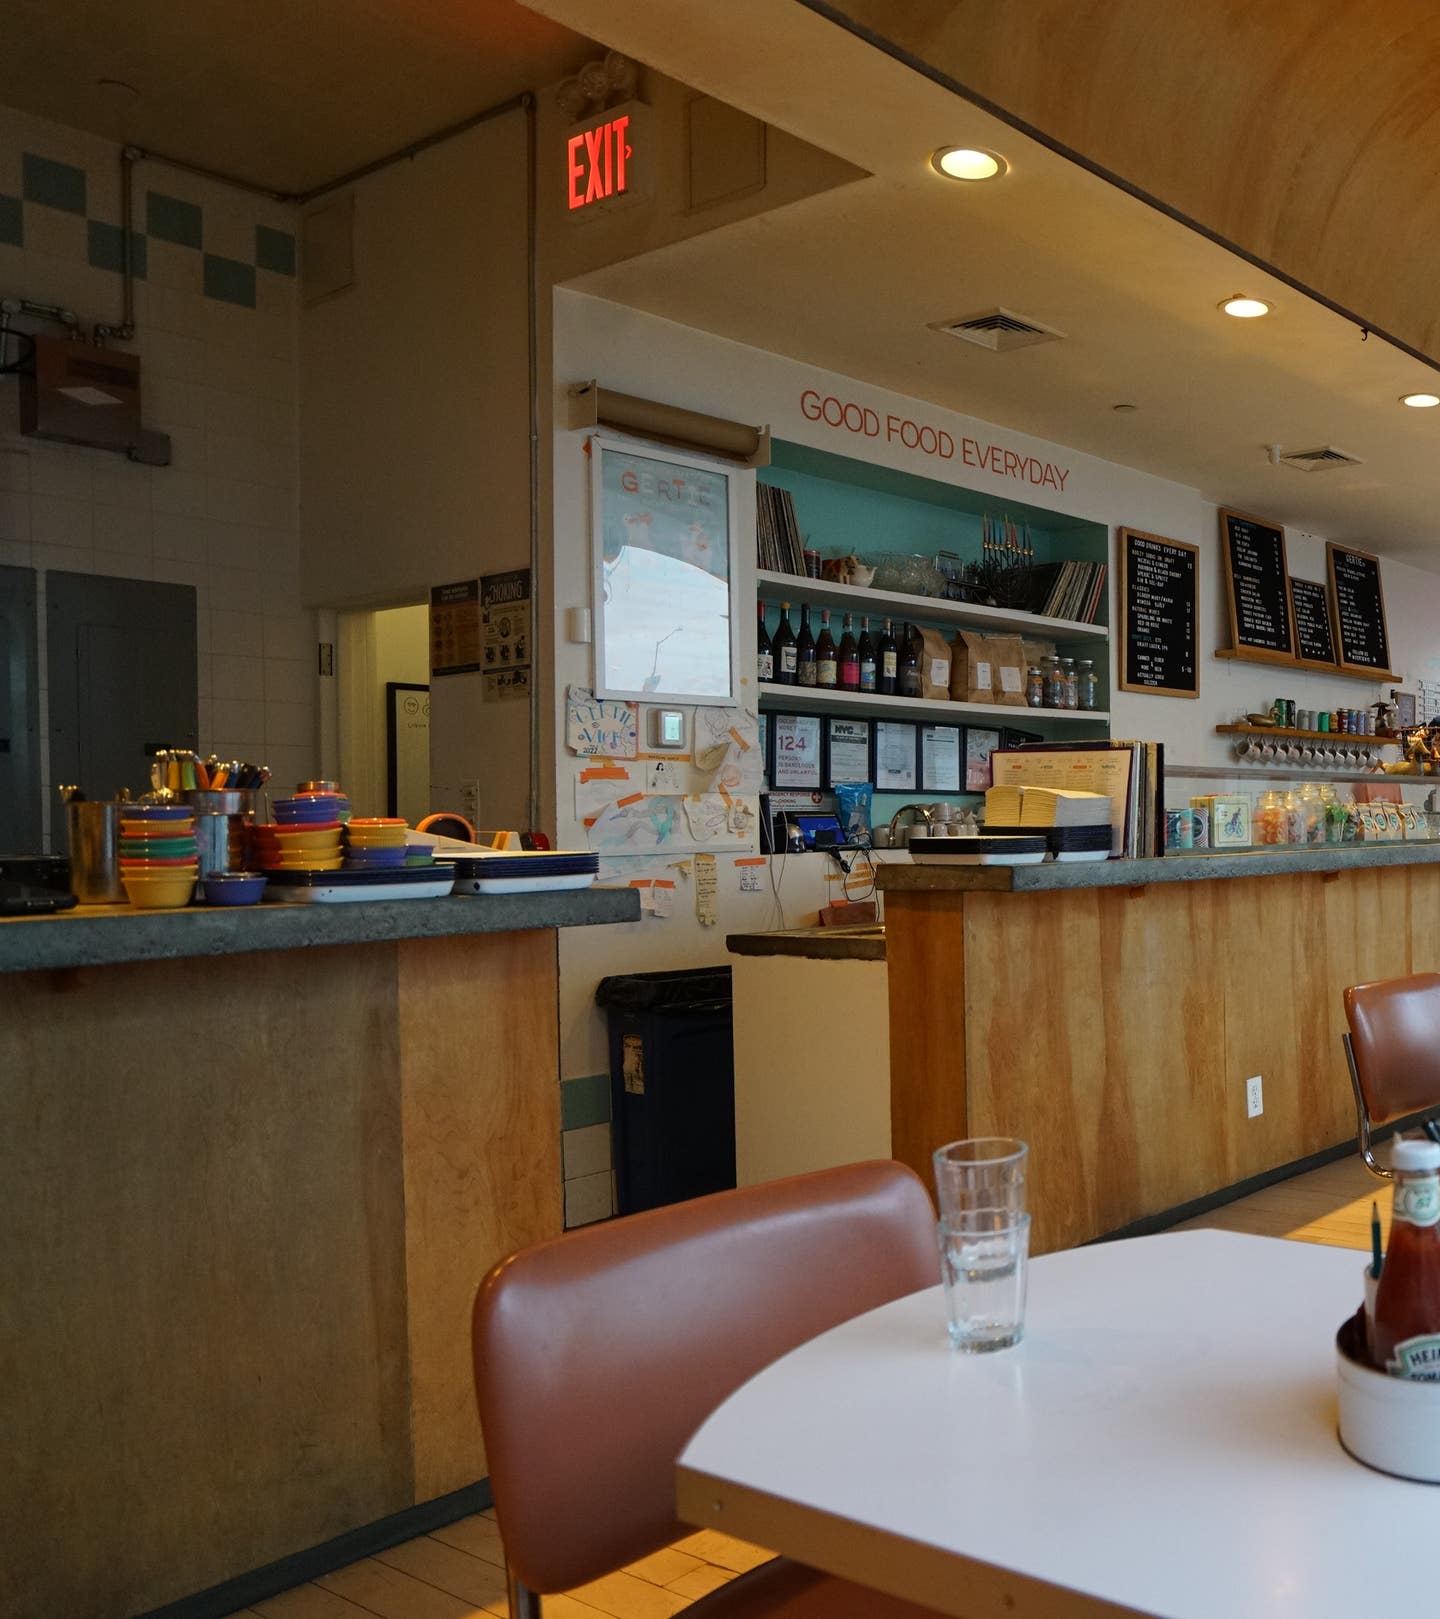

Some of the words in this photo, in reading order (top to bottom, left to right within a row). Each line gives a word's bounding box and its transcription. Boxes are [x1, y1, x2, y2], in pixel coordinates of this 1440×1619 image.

[568, 115, 630, 210] EXIT
[800, 389, 880, 437] GOOD
[887, 415, 954, 459] FOOD
[962, 438, 1070, 491] EVERYDAY
[778, 736, 806, 750] 124
